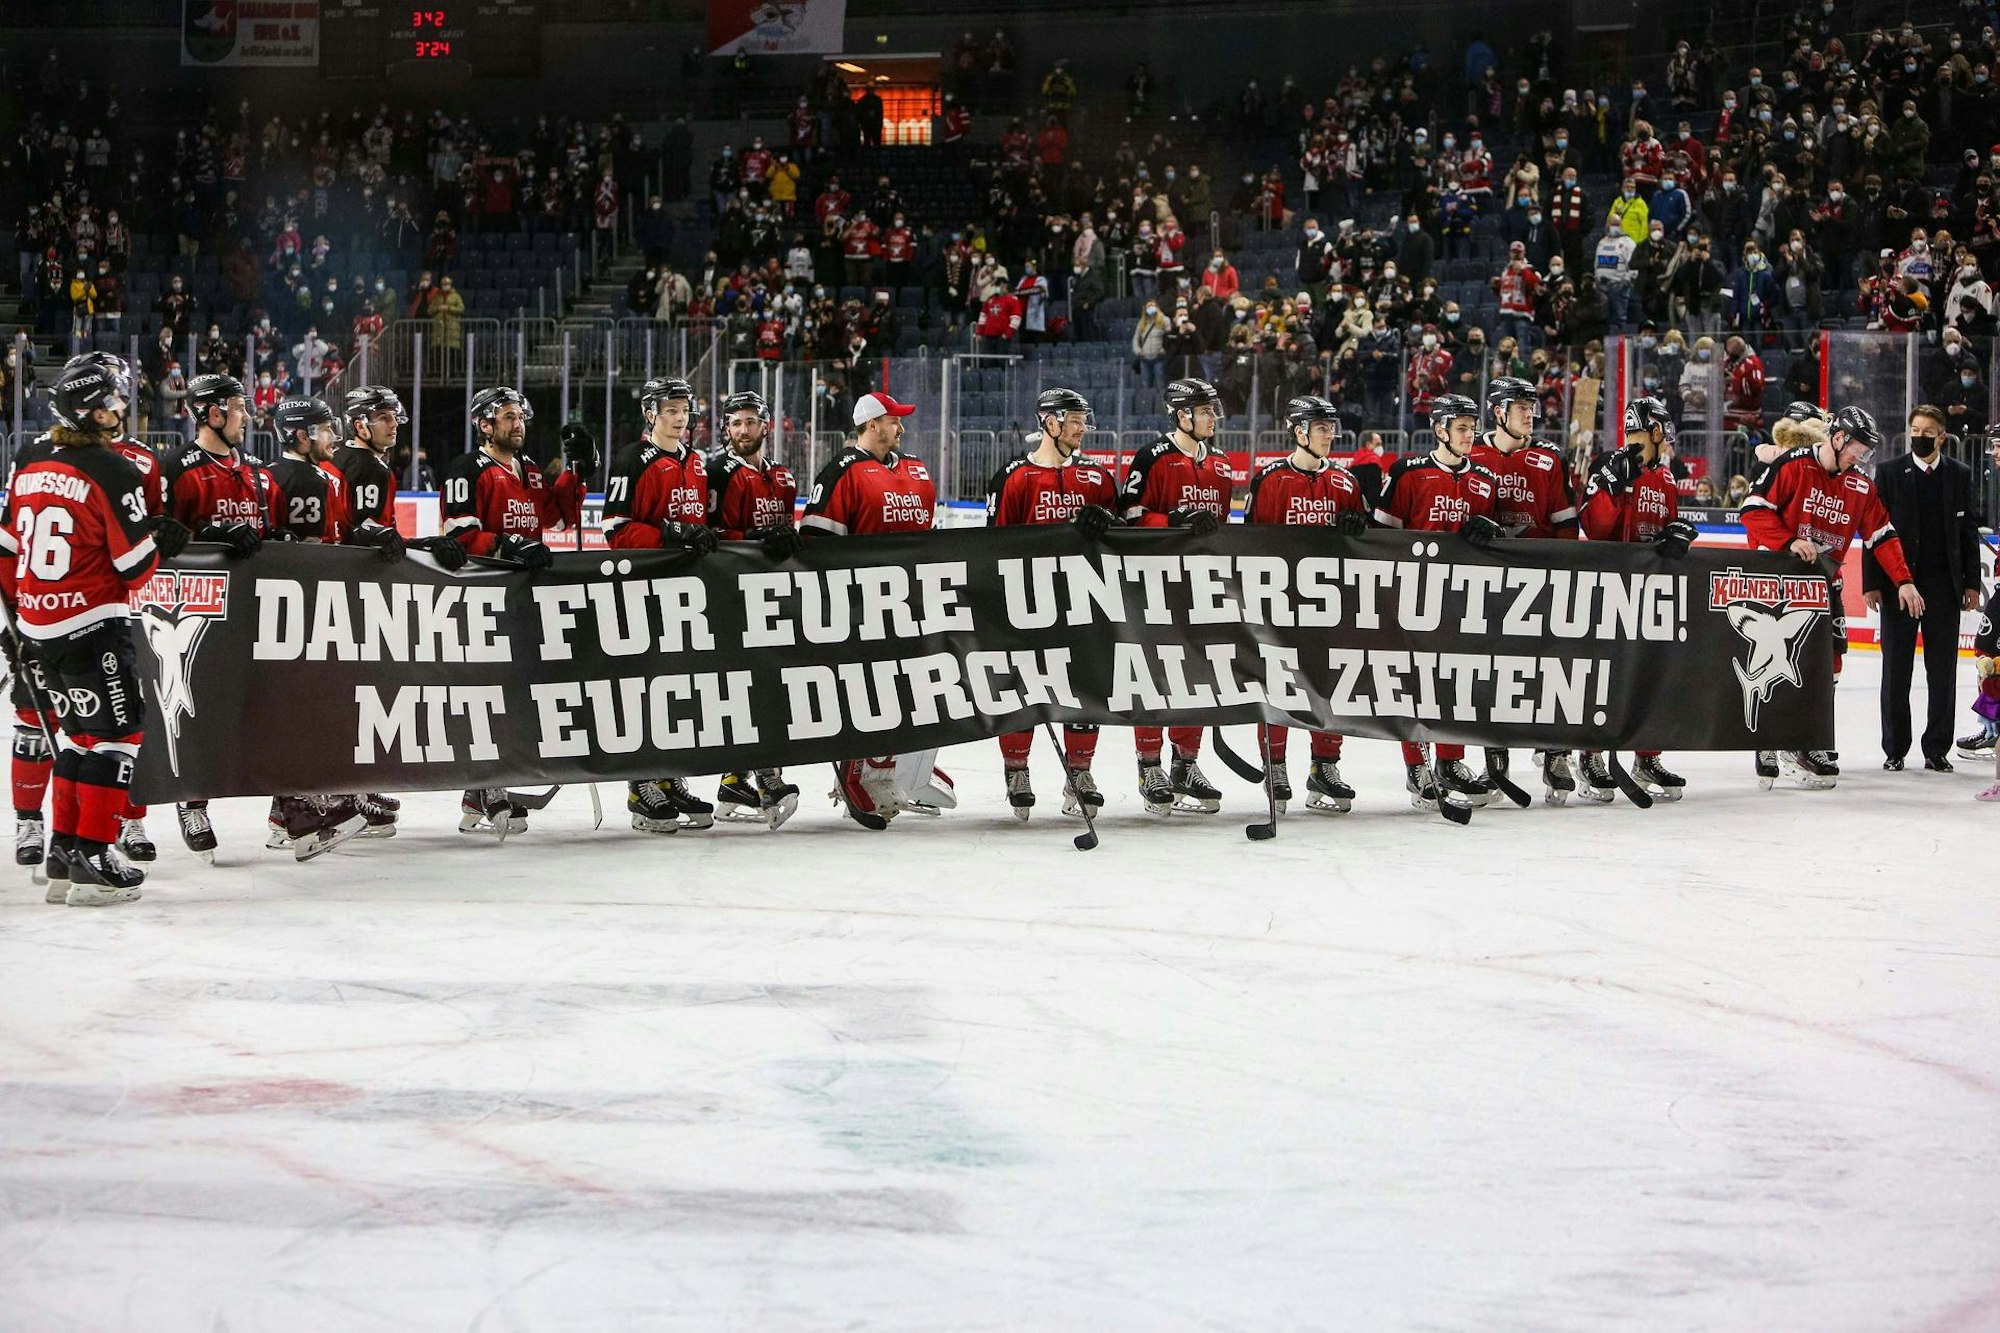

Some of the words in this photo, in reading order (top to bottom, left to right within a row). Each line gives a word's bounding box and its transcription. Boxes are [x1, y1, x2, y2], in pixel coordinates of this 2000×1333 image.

[64, 374, 103, 391] STETSON
[188, 374, 220, 388] STETSON
[1168, 382, 1195, 394] STETSON
[278, 400, 311, 411] STETSON
[608, 475, 629, 502] 71
[1494, 472, 1527, 488] hein
[355, 484, 379, 510] 19
[444, 477, 469, 504] 10
[671, 486, 699, 503] Rhein
[1040, 491, 1086, 506] Rhein
[1182, 485, 1220, 501] Rhein
[1497, 486, 1535, 503] ergie
[1640, 486, 1666, 502] Rhein
[1810, 487, 1845, 511] Rhein
[216, 498, 258, 516] Rhein
[507, 498, 536, 515] Rhein
[883, 491, 922, 508] Rhein
[1291, 497, 1336, 512] Rhein
[289, 496, 321, 524] 23
[882, 505, 930, 525] Energie
[1035, 504, 1082, 520] Energ
[1286, 510, 1337, 526] Energ
[1678, 511, 1708, 522] TETSON
[16, 506, 74, 581] 36
[180, 576, 225, 612] HAIE
[1712, 571, 1780, 606] KÖLNER
[252, 578, 512, 662] DANKE
[533, 559, 715, 661] FÜR
[738, 561, 975, 648] EURE
[998, 540, 1688, 643] UNTERSTÜTZUNG!
[107, 680, 128, 727] Hilux
[353, 685, 506, 764] MIT
[530, 670, 759, 758] EUCH
[781, 646, 1082, 740] DURCH
[1107, 642, 1311, 712] ALLE
[1328, 648, 1612, 727] ZEITEN!
